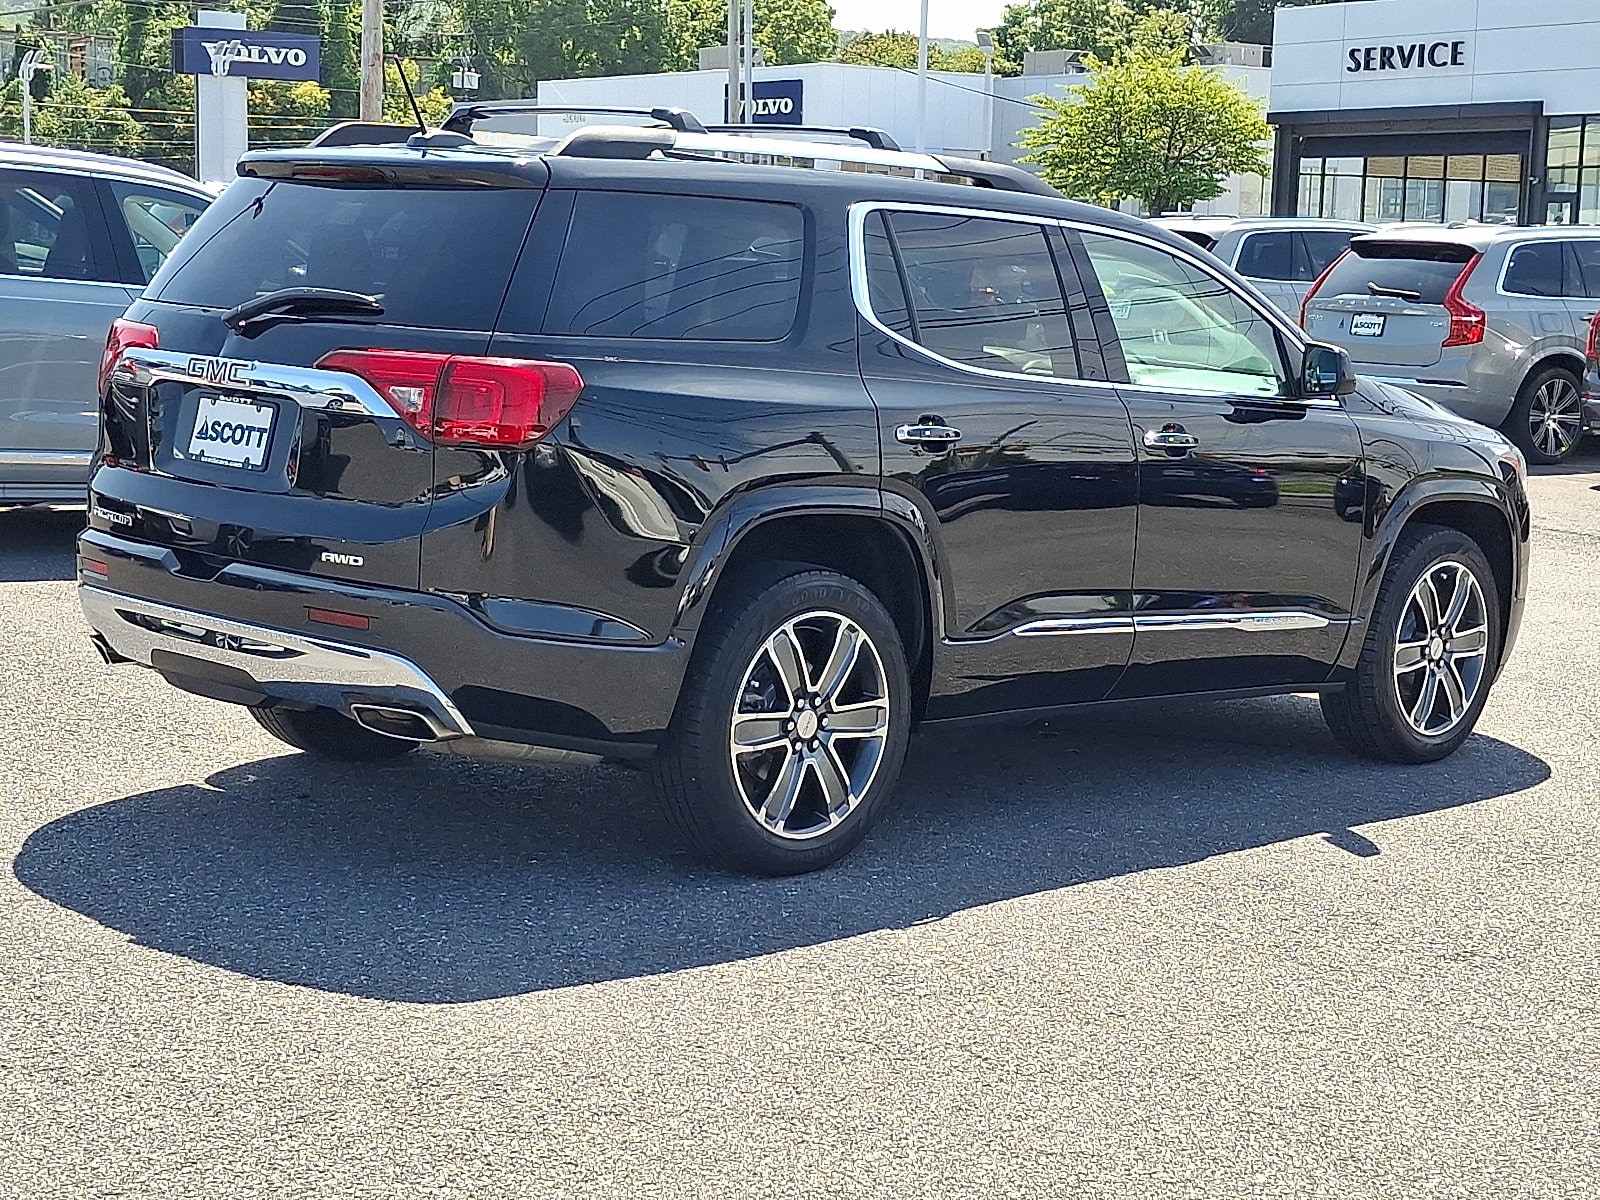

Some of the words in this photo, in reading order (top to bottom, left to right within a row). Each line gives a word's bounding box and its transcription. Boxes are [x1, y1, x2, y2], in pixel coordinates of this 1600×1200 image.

[1346, 41, 1465, 72] SERVICE
[186, 358, 253, 387] GMC
[321, 551, 364, 567] AWD
